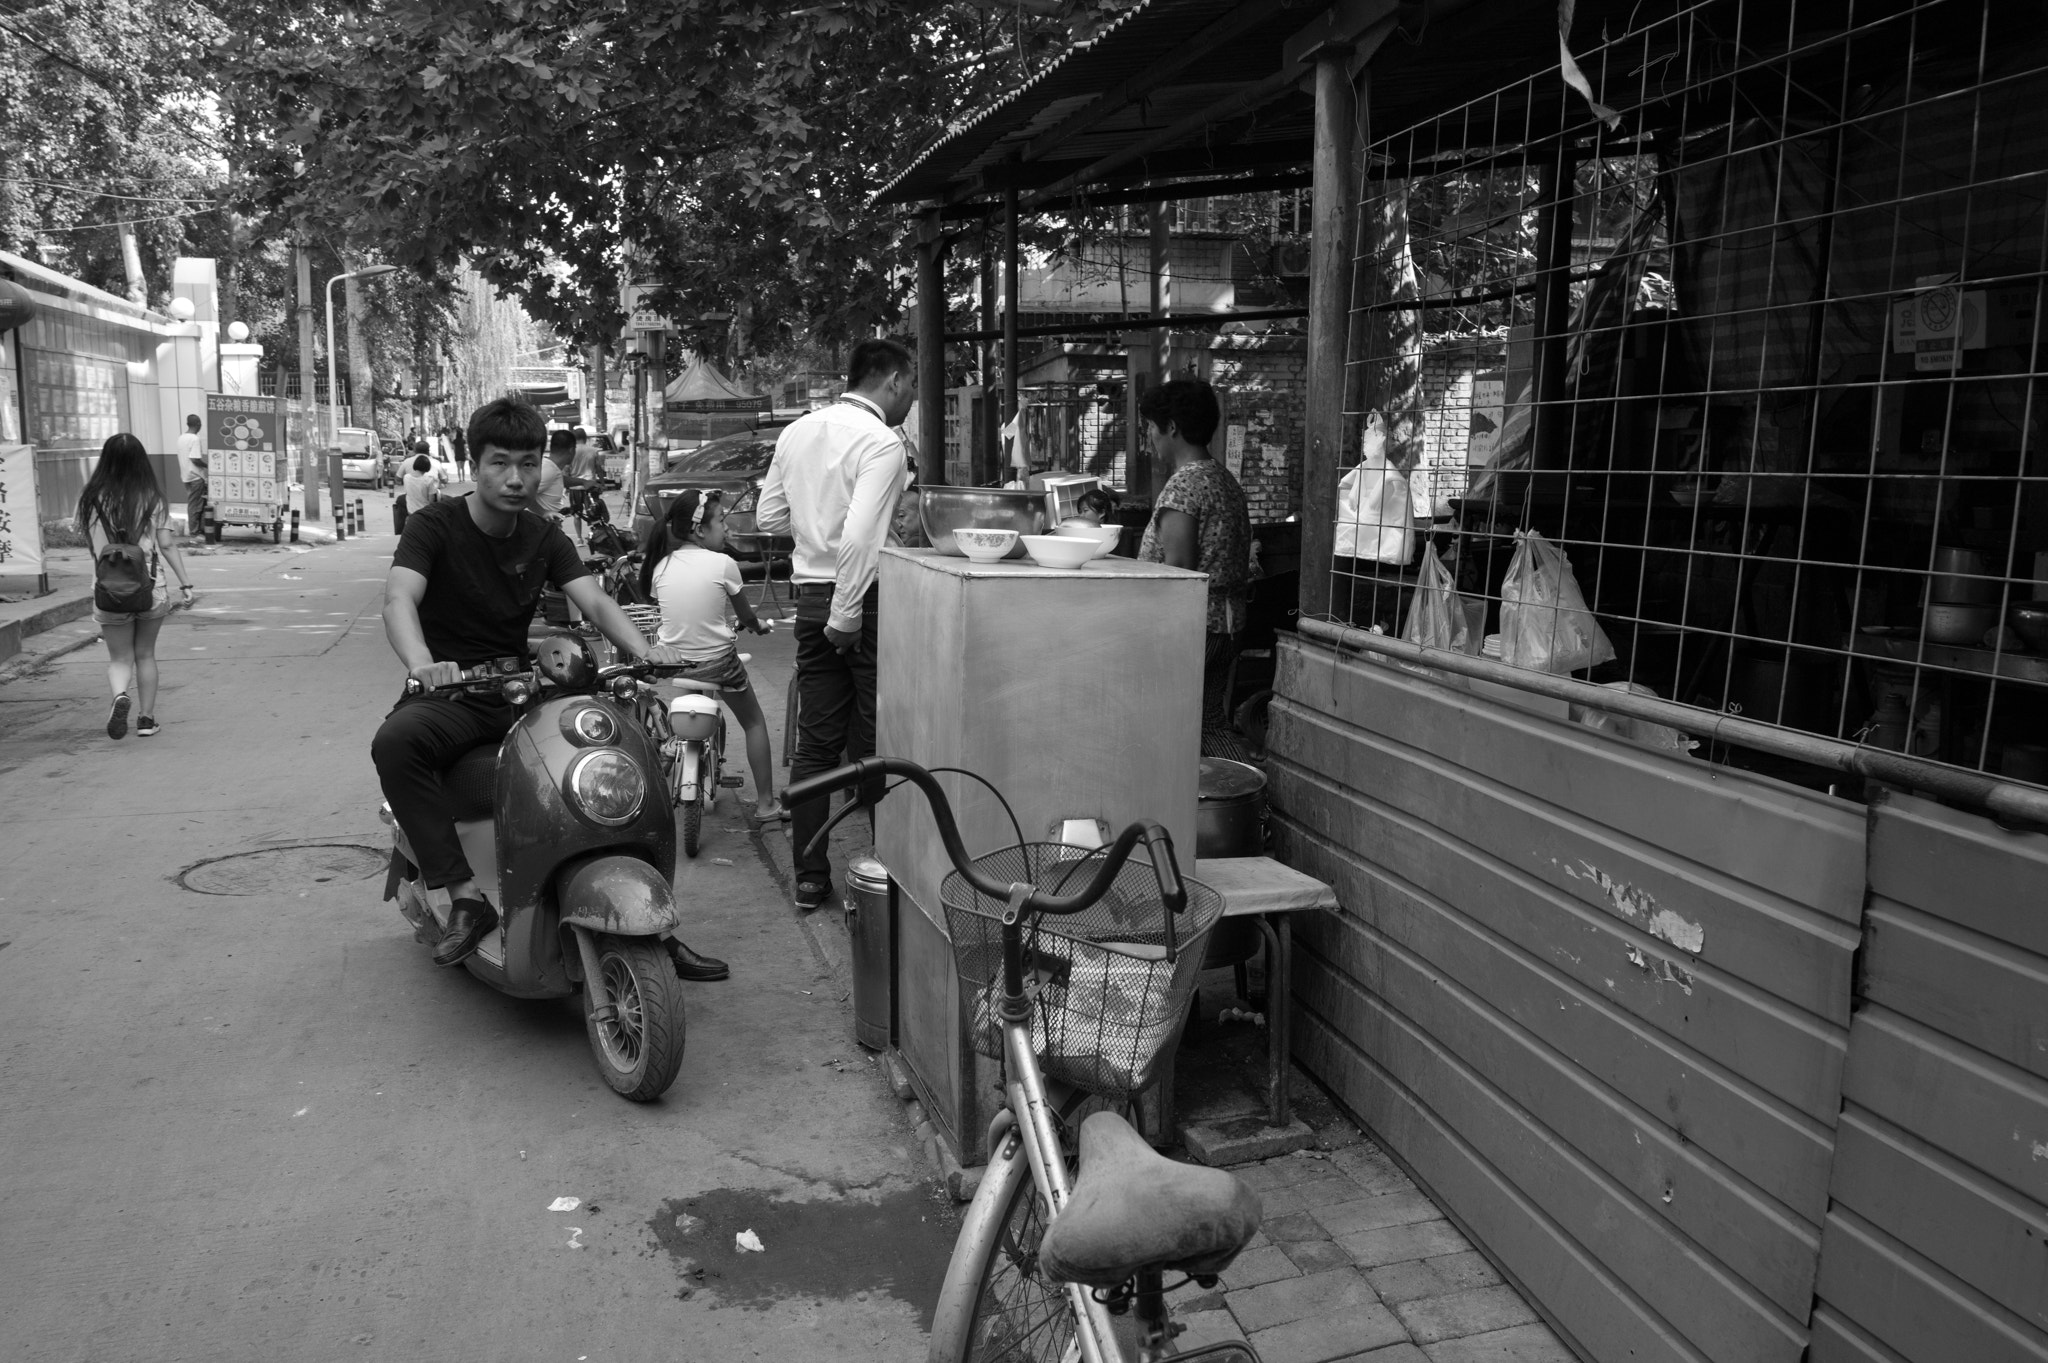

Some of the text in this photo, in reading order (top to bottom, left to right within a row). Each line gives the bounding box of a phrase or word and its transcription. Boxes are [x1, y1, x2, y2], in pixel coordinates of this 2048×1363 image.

[1930, 354, 1954, 363] SMOKIN
[208, 398, 275, 414] 五谷杂粮香脆煎饼
[736, 400, 763, 409] 95079
